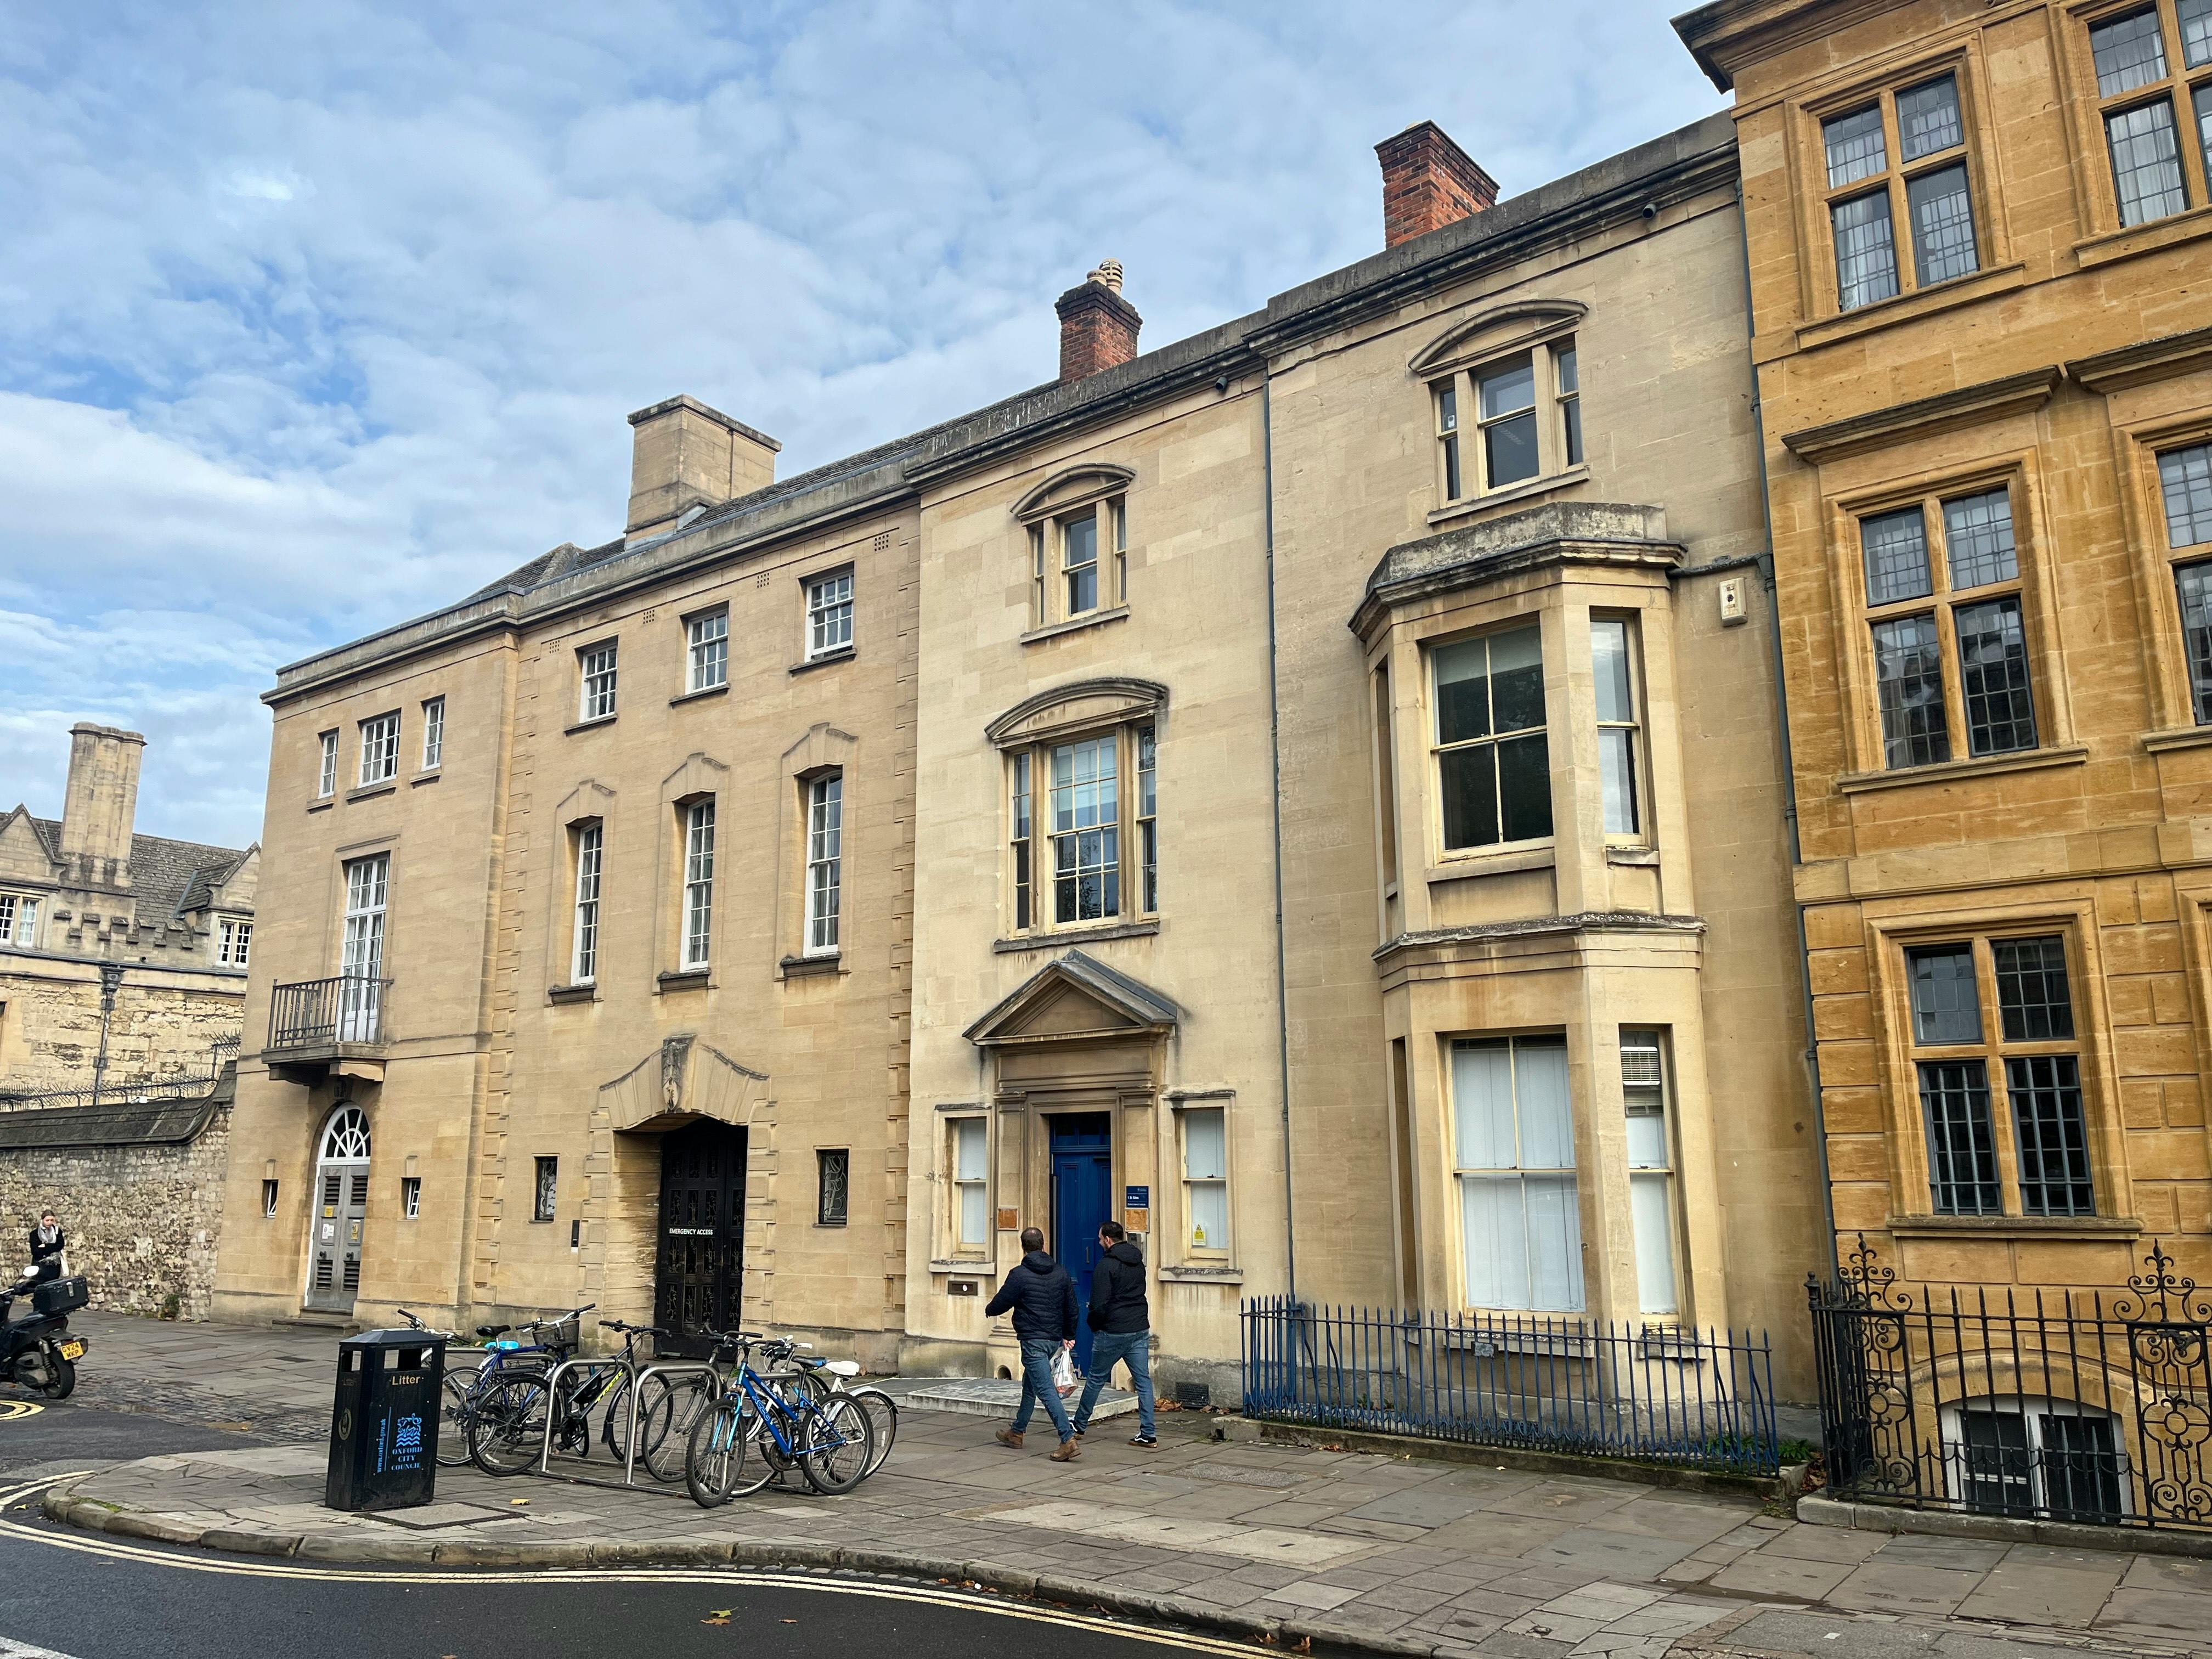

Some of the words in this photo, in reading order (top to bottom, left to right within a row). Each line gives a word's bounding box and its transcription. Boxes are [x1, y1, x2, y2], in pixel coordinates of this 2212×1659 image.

[62, 1343, 79, 1352] GV24
[392, 1375, 420, 1385] Litter
[595, 1369, 623, 1403] TREK
[377, 1418, 386, 1473] www.oxford.gov.uk
[392, 1446, 422, 1454] OXFORD
